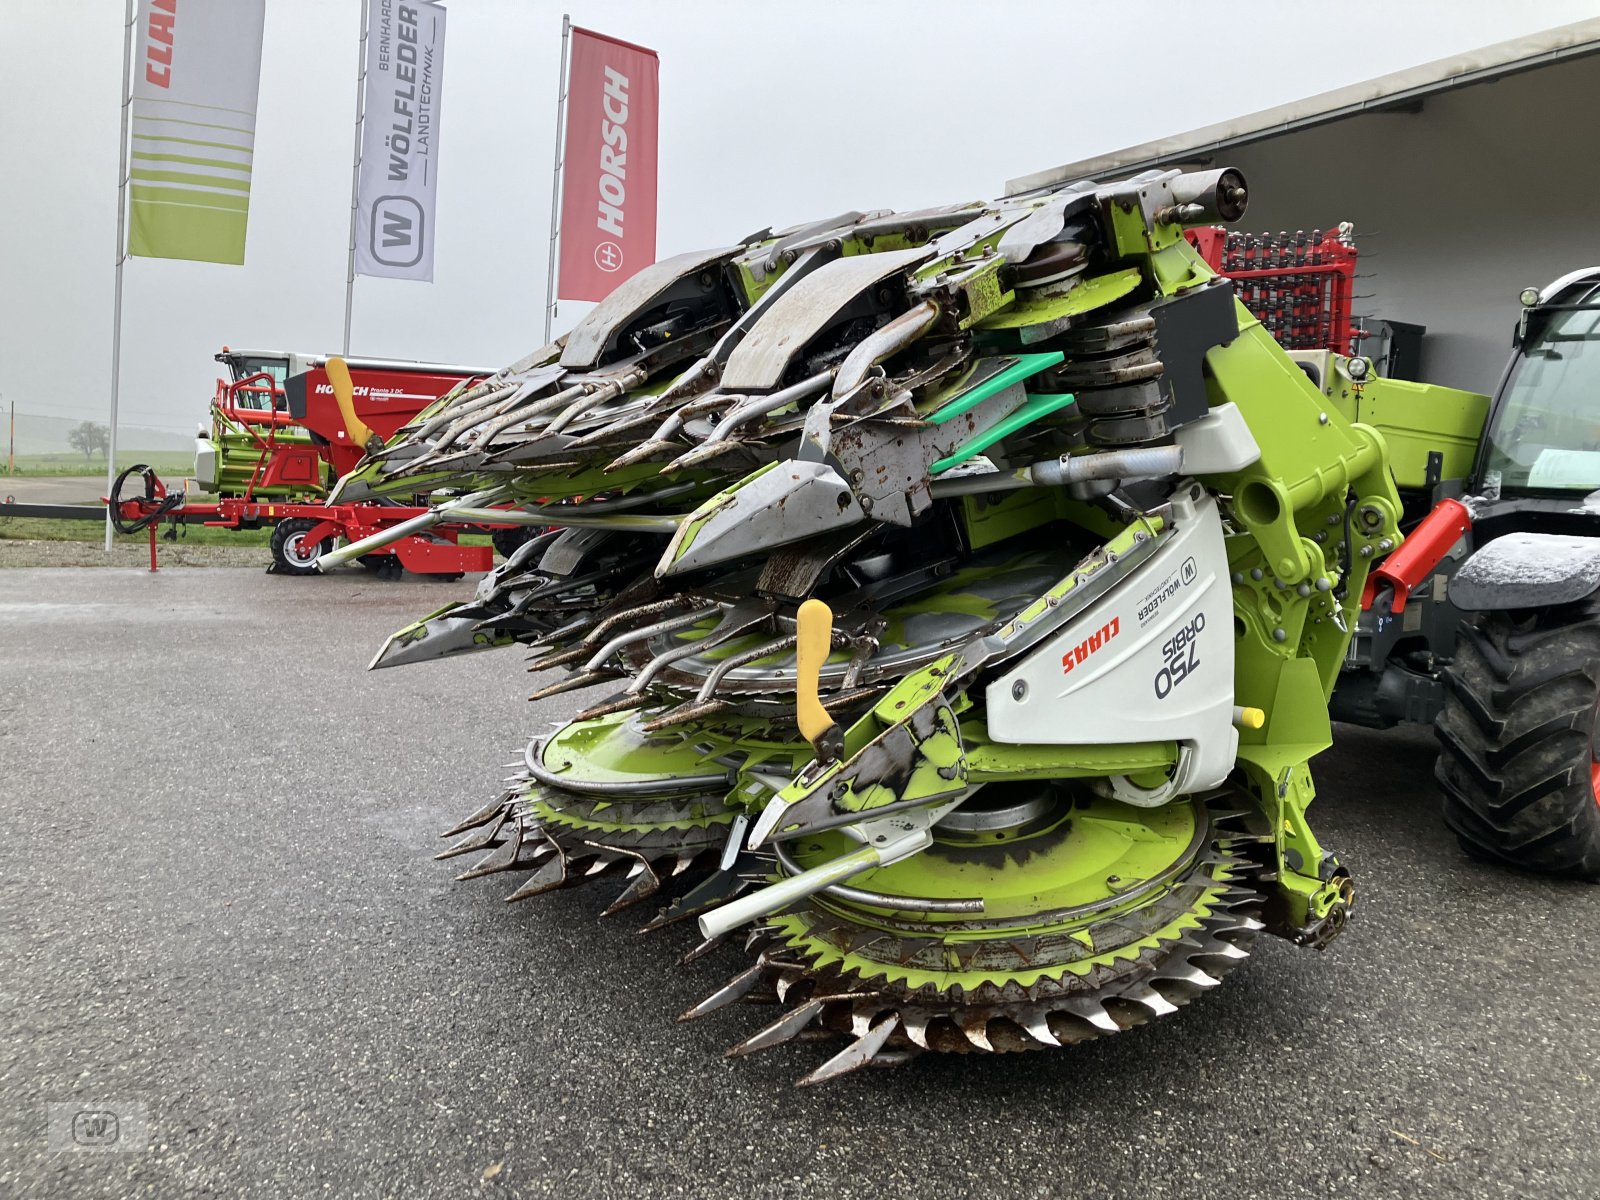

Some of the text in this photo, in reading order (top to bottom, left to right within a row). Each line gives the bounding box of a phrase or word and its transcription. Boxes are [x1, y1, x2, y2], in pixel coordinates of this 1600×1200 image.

[385, 4, 418, 181] WÖLFLEDER
[417, 45, 434, 155] LANDTECHNIK
[597, 65, 629, 238] HORSCH
[382, 210, 412, 248] W
[315, 384, 369, 396] HOCH
[1185, 563, 1194, 579] W
[1138, 579, 1181, 621] WÖLFLEDER
[1061, 616, 1120, 674] CLAAS
[1163, 612, 1205, 663] ORBIS
[1154, 641, 1201, 699] 750
